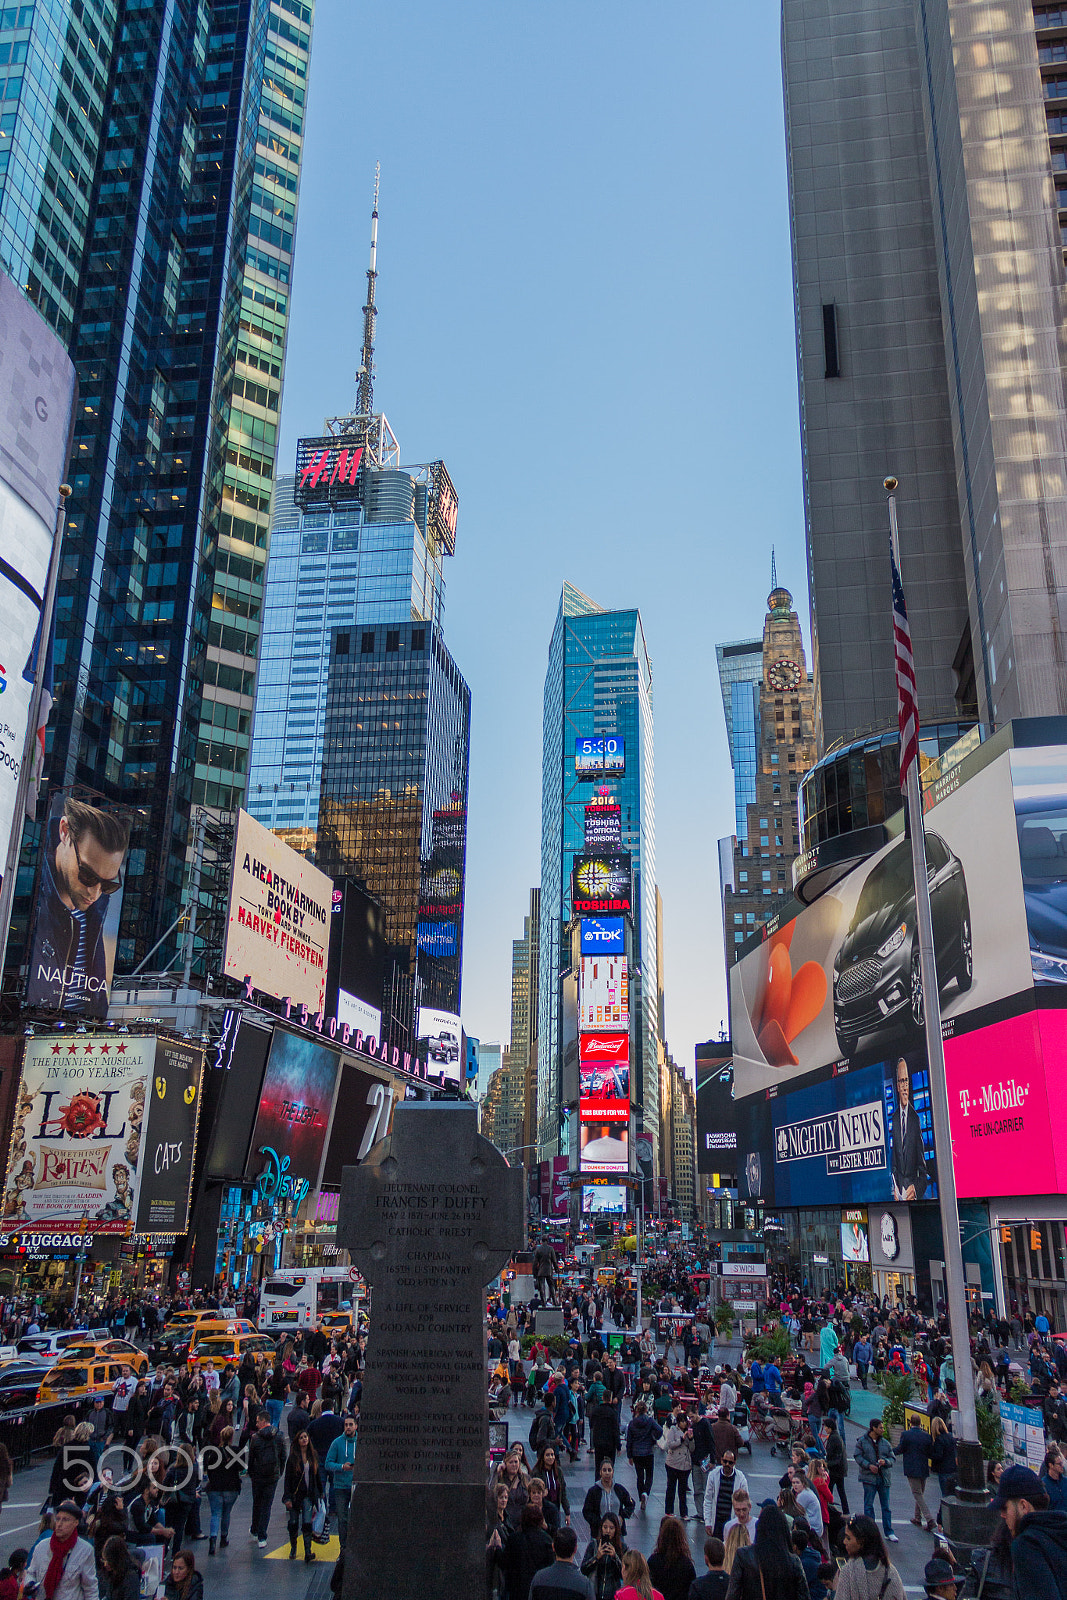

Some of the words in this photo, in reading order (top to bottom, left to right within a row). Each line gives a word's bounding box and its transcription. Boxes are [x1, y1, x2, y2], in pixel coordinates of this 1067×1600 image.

[300, 447, 364, 488] H&M
[582, 739, 617, 754] 5:30
[935, 764, 962, 792] MARRIOTT
[935, 778, 960, 802] MARQUIS
[591, 796, 615, 805] 2016
[242, 852, 251, 874] A
[252, 858, 327, 925] HEARTWARMING
[267, 890, 292, 921] BOOK
[292, 907, 306, 928] BY
[574, 900, 631, 910] TOSHIBA
[238, 905, 279, 943] HARVEY
[281, 930, 324, 970] FIERSTEIN
[593, 931, 621, 940] TDK
[37, 964, 109, 994] NAUTICA
[284, 996, 337, 1038] 1540
[341, 1022, 429, 1079] BROADWAY
[588, 1041, 621, 1050] Budweiser
[32, 1057, 50, 1067] THE
[52, 1057, 99, 1067] FUNNIEST
[101, 1055, 143, 1066] MUSICAL
[47, 1069, 59, 1078] IN
[63, 1069, 84, 1079] 400
[840, 1109, 882, 1147] NEWS
[970, 1123, 983, 1138] THE
[983, 1116, 1025, 1136] UN-CARRIER
[788, 1119, 839, 1157] NIGHTLY
[49, 1149, 100, 1158] SOMETHING
[154, 1141, 183, 1174] CATS
[779, 1150, 788, 1158] NBC
[839, 1153, 862, 1169] LESTER
[863, 1149, 882, 1167] HOLT
[384, 1183, 435, 1193] LIEUTENANT
[438, 1184, 480, 1194] COLONEL
[375, 1196, 427, 1208] FRANCIS
[445, 1196, 488, 1208] DUFFY
[382, 1211, 398, 1220] MAY
[401, 1211, 405, 1219] 2
[451, 1212, 461, 1220] 26
[388, 1227, 434, 1236] CATHOLIC
[439, 1228, 472, 1236] PRIEST
[21, 1234, 93, 1247] LUGGAGE
[407, 1252, 451, 1261] CHAPLAIN
[397, 1278, 416, 1287] OLD
[386, 1303, 391, 1311] A
[396, 1304, 414, 1312] LIFE
[417, 1304, 429, 1312] OF
[433, 1303, 470, 1313] SERVICE
[418, 1313, 434, 1321] FOR
[380, 1323, 402, 1332] GOD
[405, 1323, 425, 1332] AND
[428, 1324, 472, 1333] COUNTRY
[376, 1349, 409, 1357] SPANISH
[410, 1350, 452, 1358] AMERICAN
[455, 1350, 473, 1358] WAR
[366, 1361, 385, 1369] NEW
[387, 1361, 408, 1370] YORK
[411, 1362, 450, 1370] NATIONAL
[454, 1362, 483, 1371] GUARD
[387, 1373, 425, 1382] MEXICAN
[427, 1374, 460, 1382] BORDER
[395, 1386, 426, 1394] WORLD
[432, 1386, 451, 1394] WAR
[361, 1412, 420, 1421] DISTINGUISHED
[424, 1412, 453, 1421] SERVICE
[458, 1413, 484, 1422] CROSS
[360, 1424, 419, 1433] DISTINGUISHED
[423, 1425, 453, 1433] SERVICE
[456, 1425, 483, 1434] MEDAL
[422, 1438, 453, 1447] SERVICE
[456, 1438, 483, 1447] CROSS
[380, 1451, 409, 1459] LEGION
